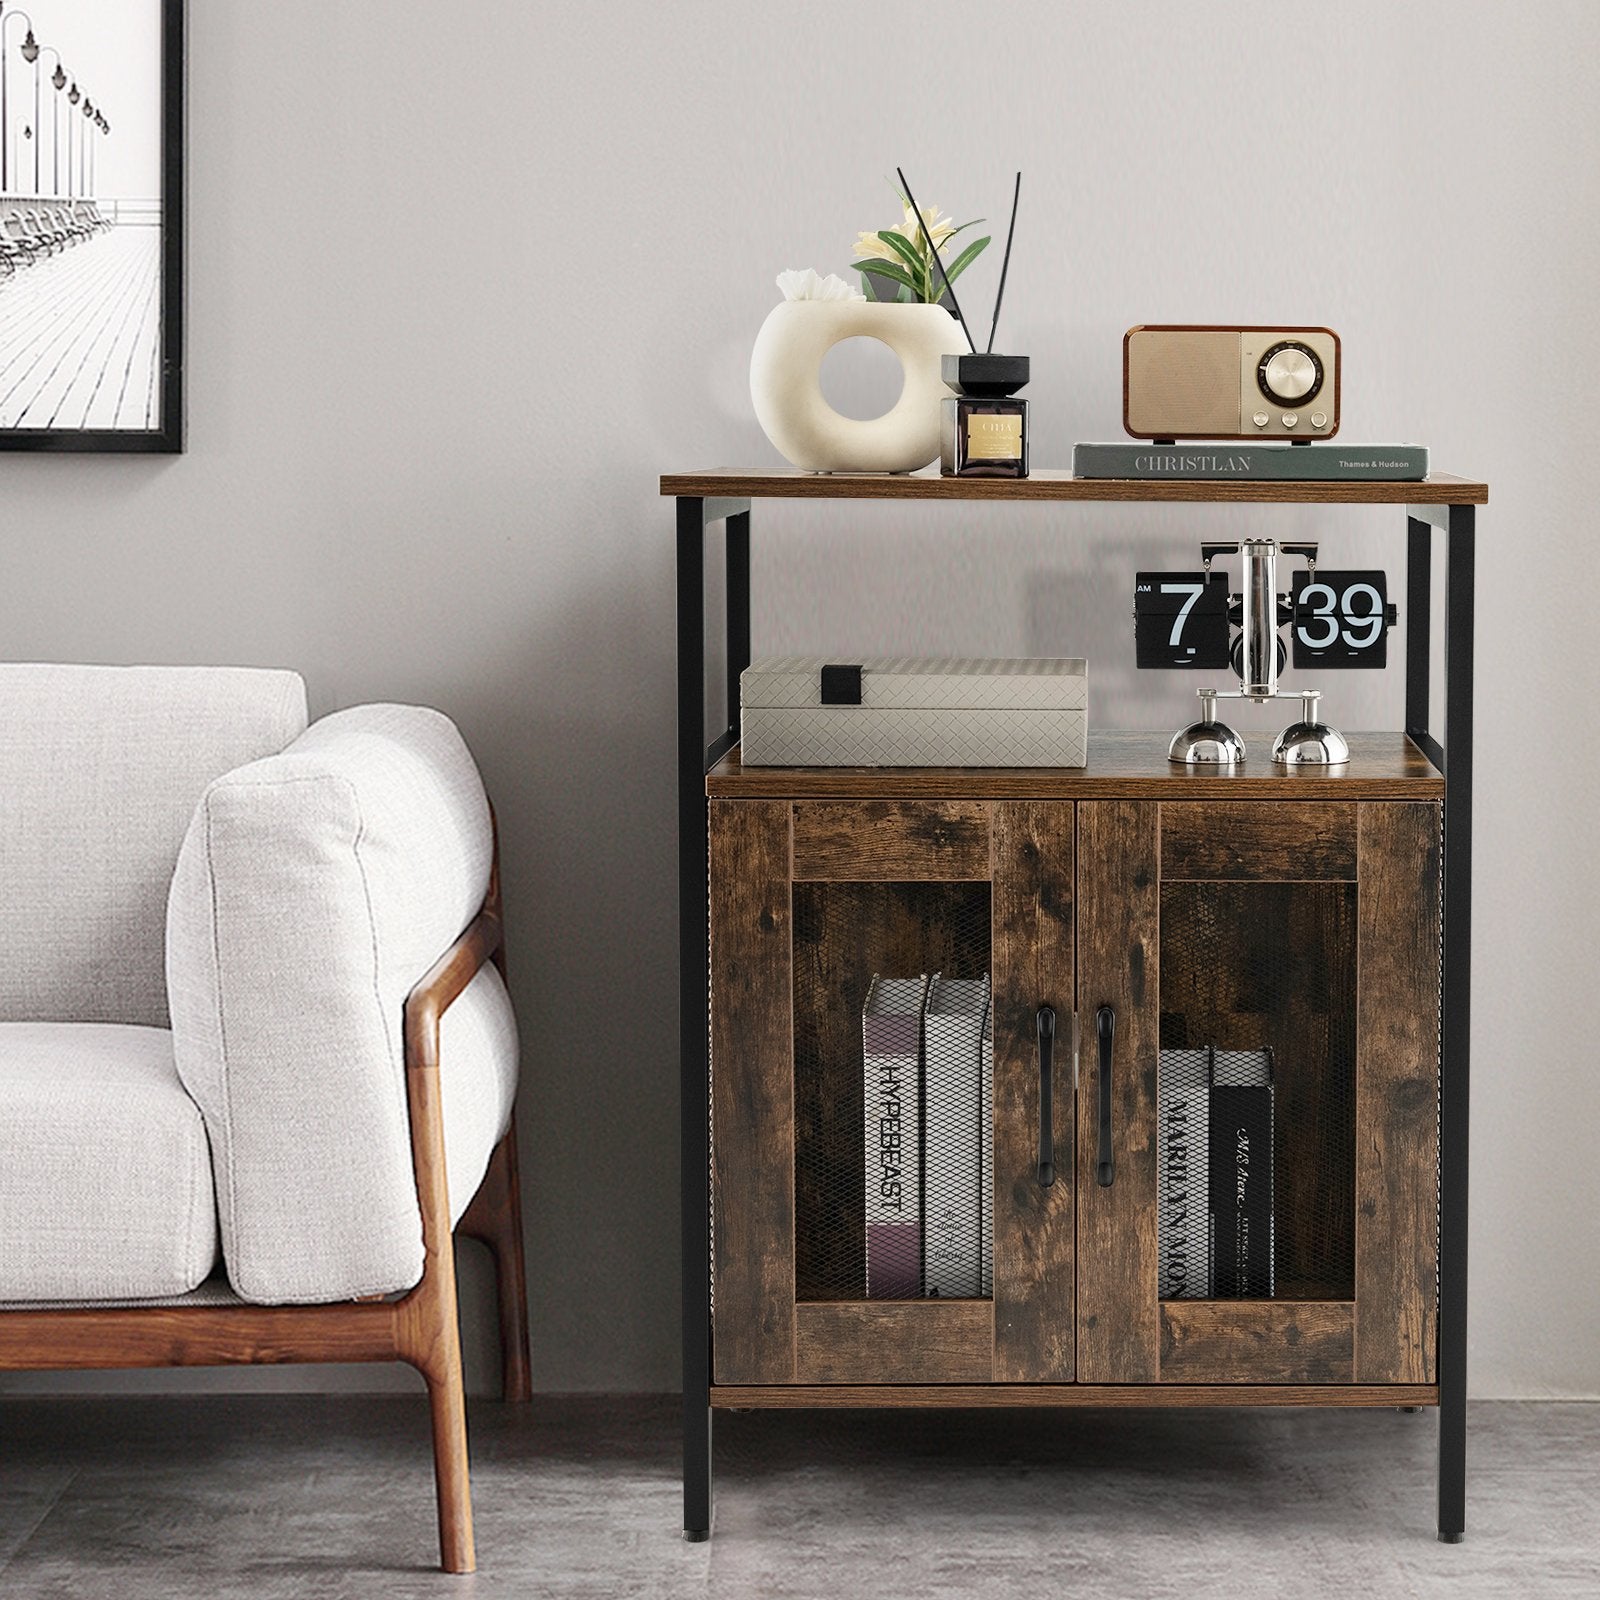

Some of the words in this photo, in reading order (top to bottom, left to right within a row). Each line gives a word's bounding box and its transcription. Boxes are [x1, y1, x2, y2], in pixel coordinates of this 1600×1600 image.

[1135, 456, 1251, 471] CHRISTLAN
[1297, 583, 1383, 649] 39
[880, 1066, 901, 1212] HYPEBEAST
[1168, 1100, 1187, 1229] MARILYN
